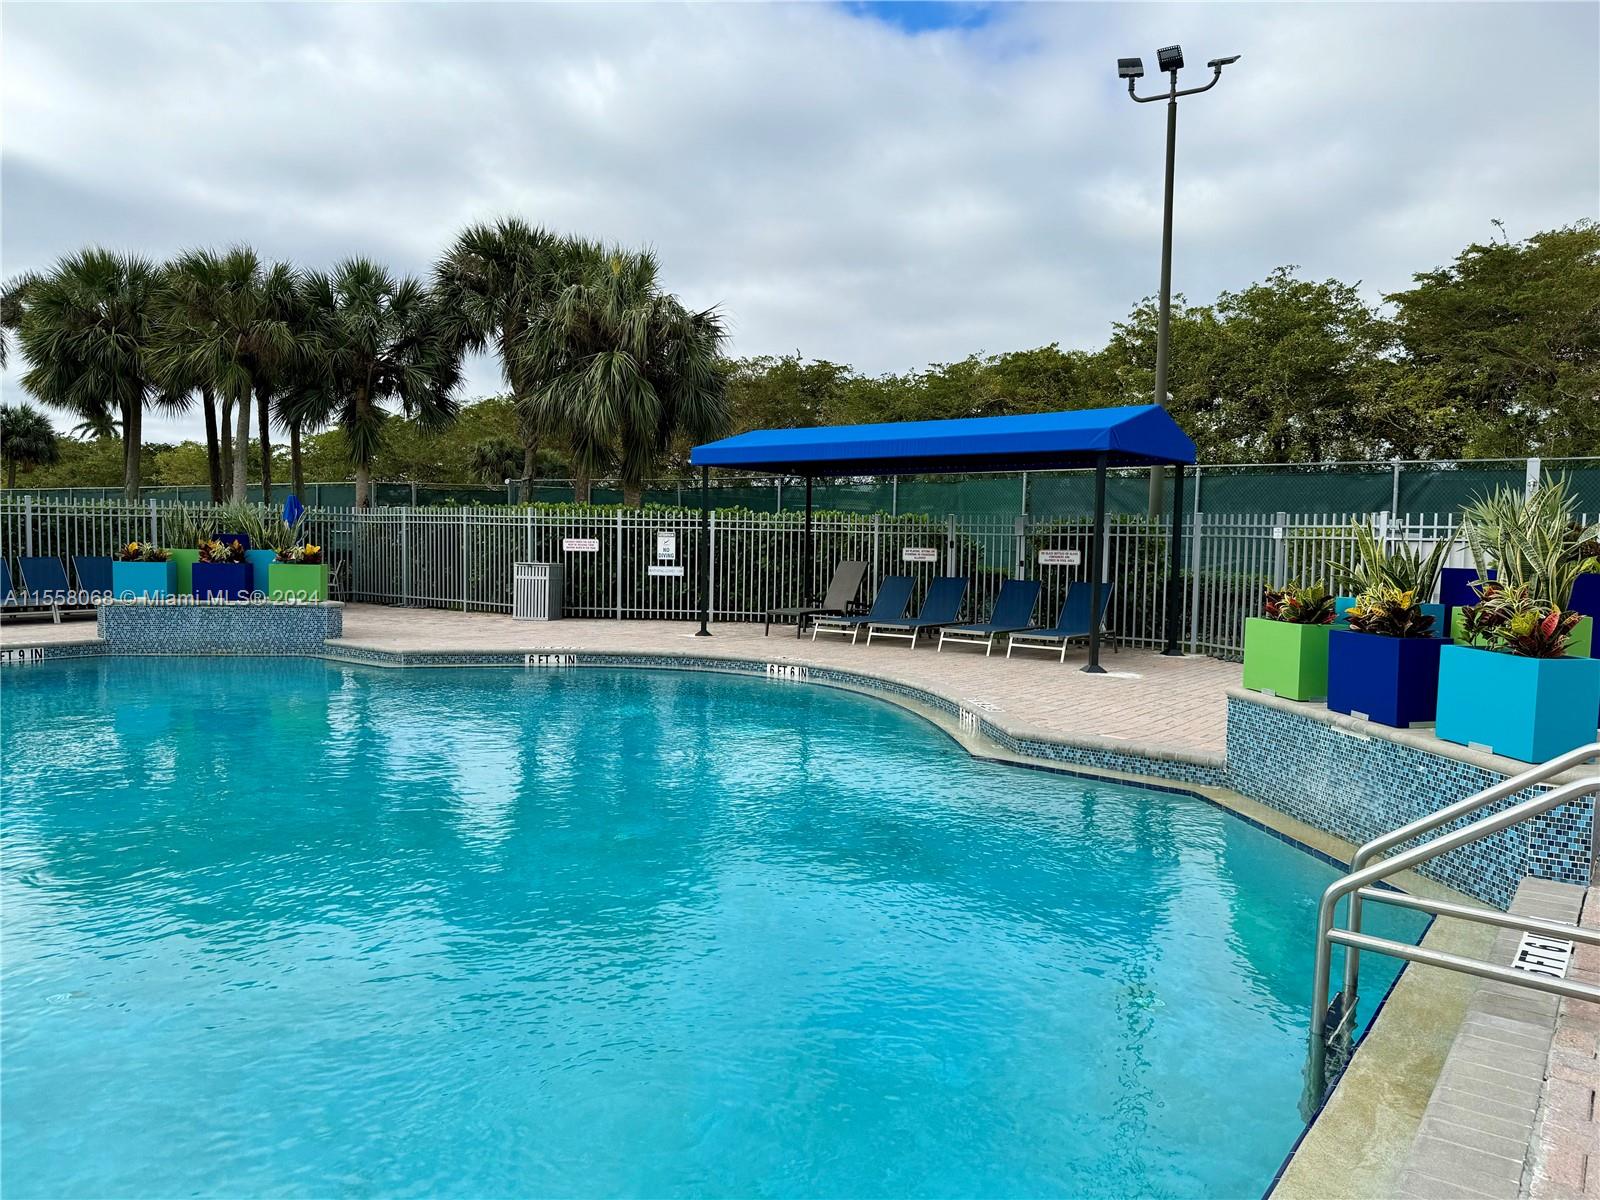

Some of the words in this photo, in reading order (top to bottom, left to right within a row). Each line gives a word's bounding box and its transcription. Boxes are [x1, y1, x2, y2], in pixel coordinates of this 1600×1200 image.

[18, 649, 25, 660] 9
[30, 648, 43, 660] IN
[528, 654, 535, 664] 6
[538, 654, 550, 664] FT
[564, 654, 576, 665] IN
[769, 664, 775, 675] 6
[777, 665, 788, 677] FT
[790, 666, 796, 677] 6
[798, 667, 807, 678] IN
[1524, 942, 1568, 953] 6
[1517, 949, 1566, 970] FT
